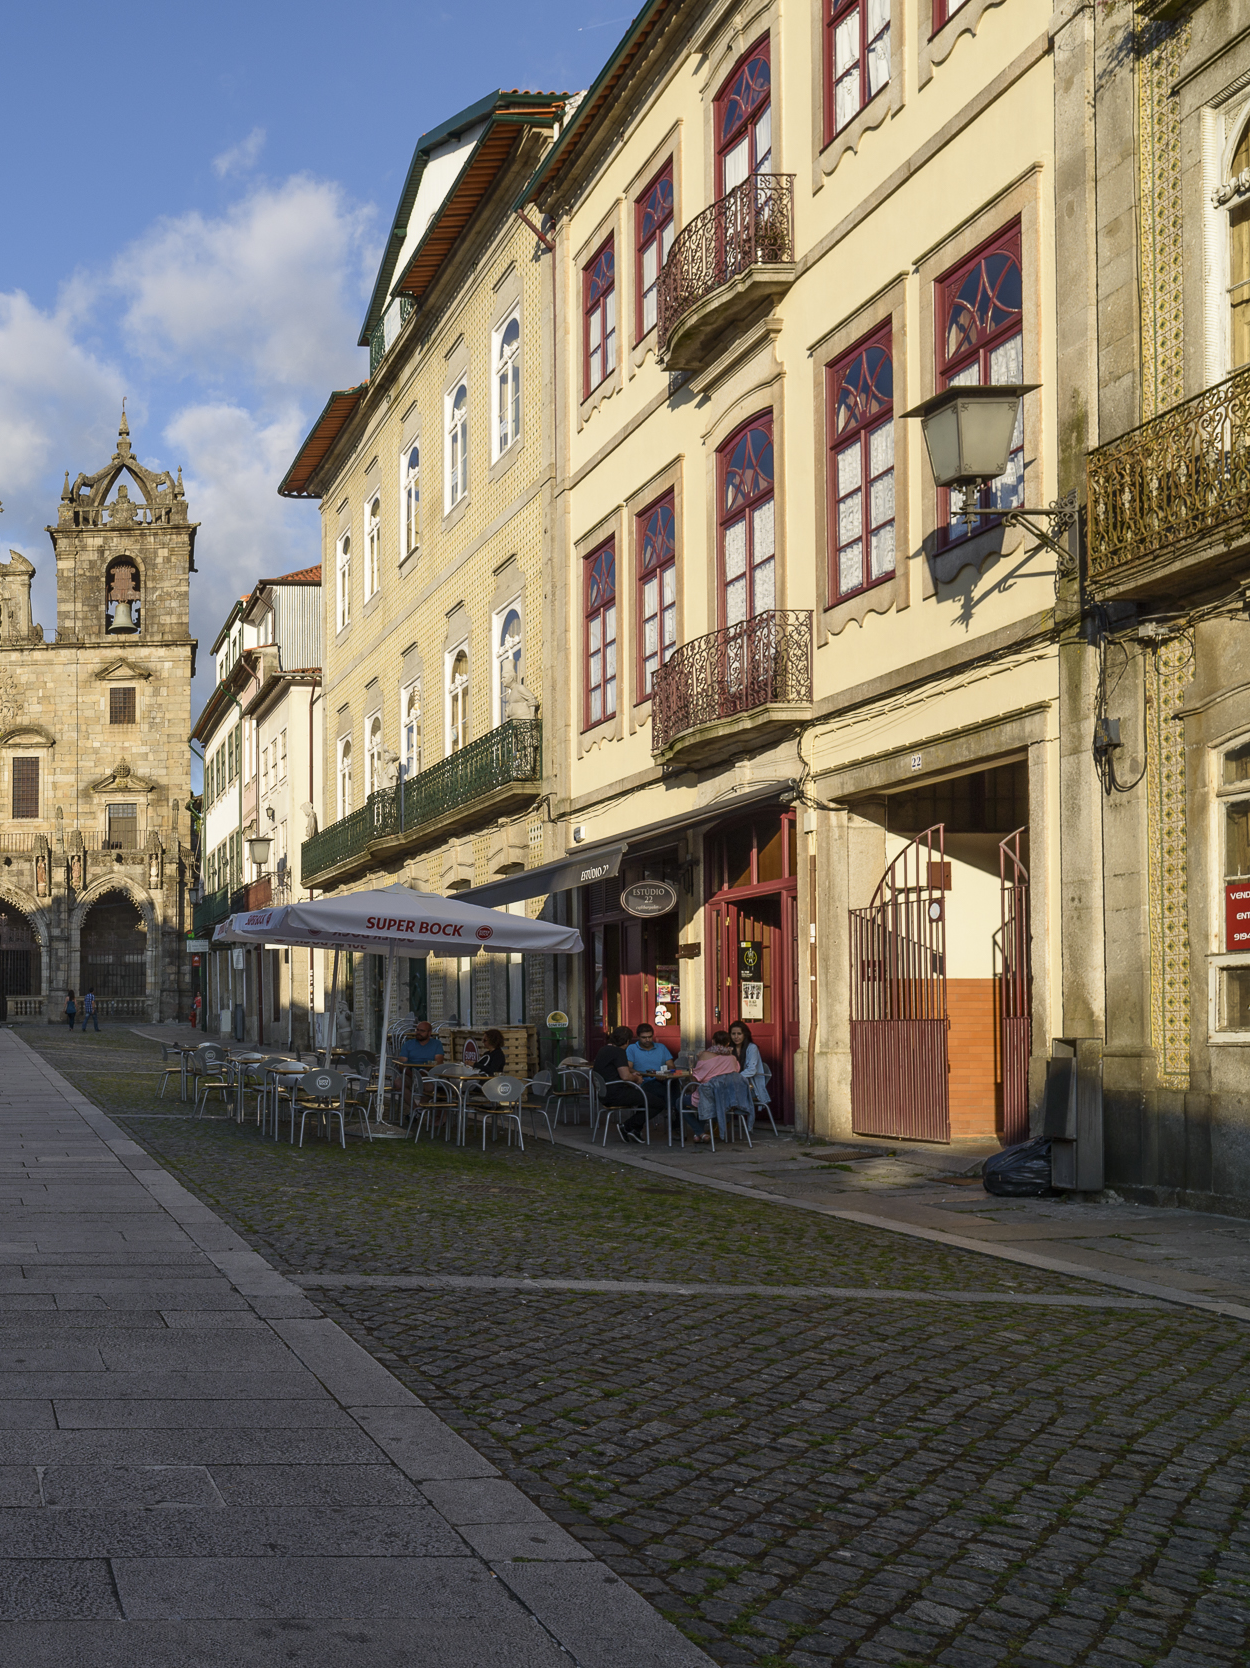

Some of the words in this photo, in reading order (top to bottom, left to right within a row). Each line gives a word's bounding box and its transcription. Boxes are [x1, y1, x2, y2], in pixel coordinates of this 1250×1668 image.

[912, 756, 921, 768] 22
[633, 887, 665, 896] ESTÚDIO
[644, 895, 653, 903] 22
[366, 916, 416, 933] SUPER
[418, 921, 465, 937] BOCK
